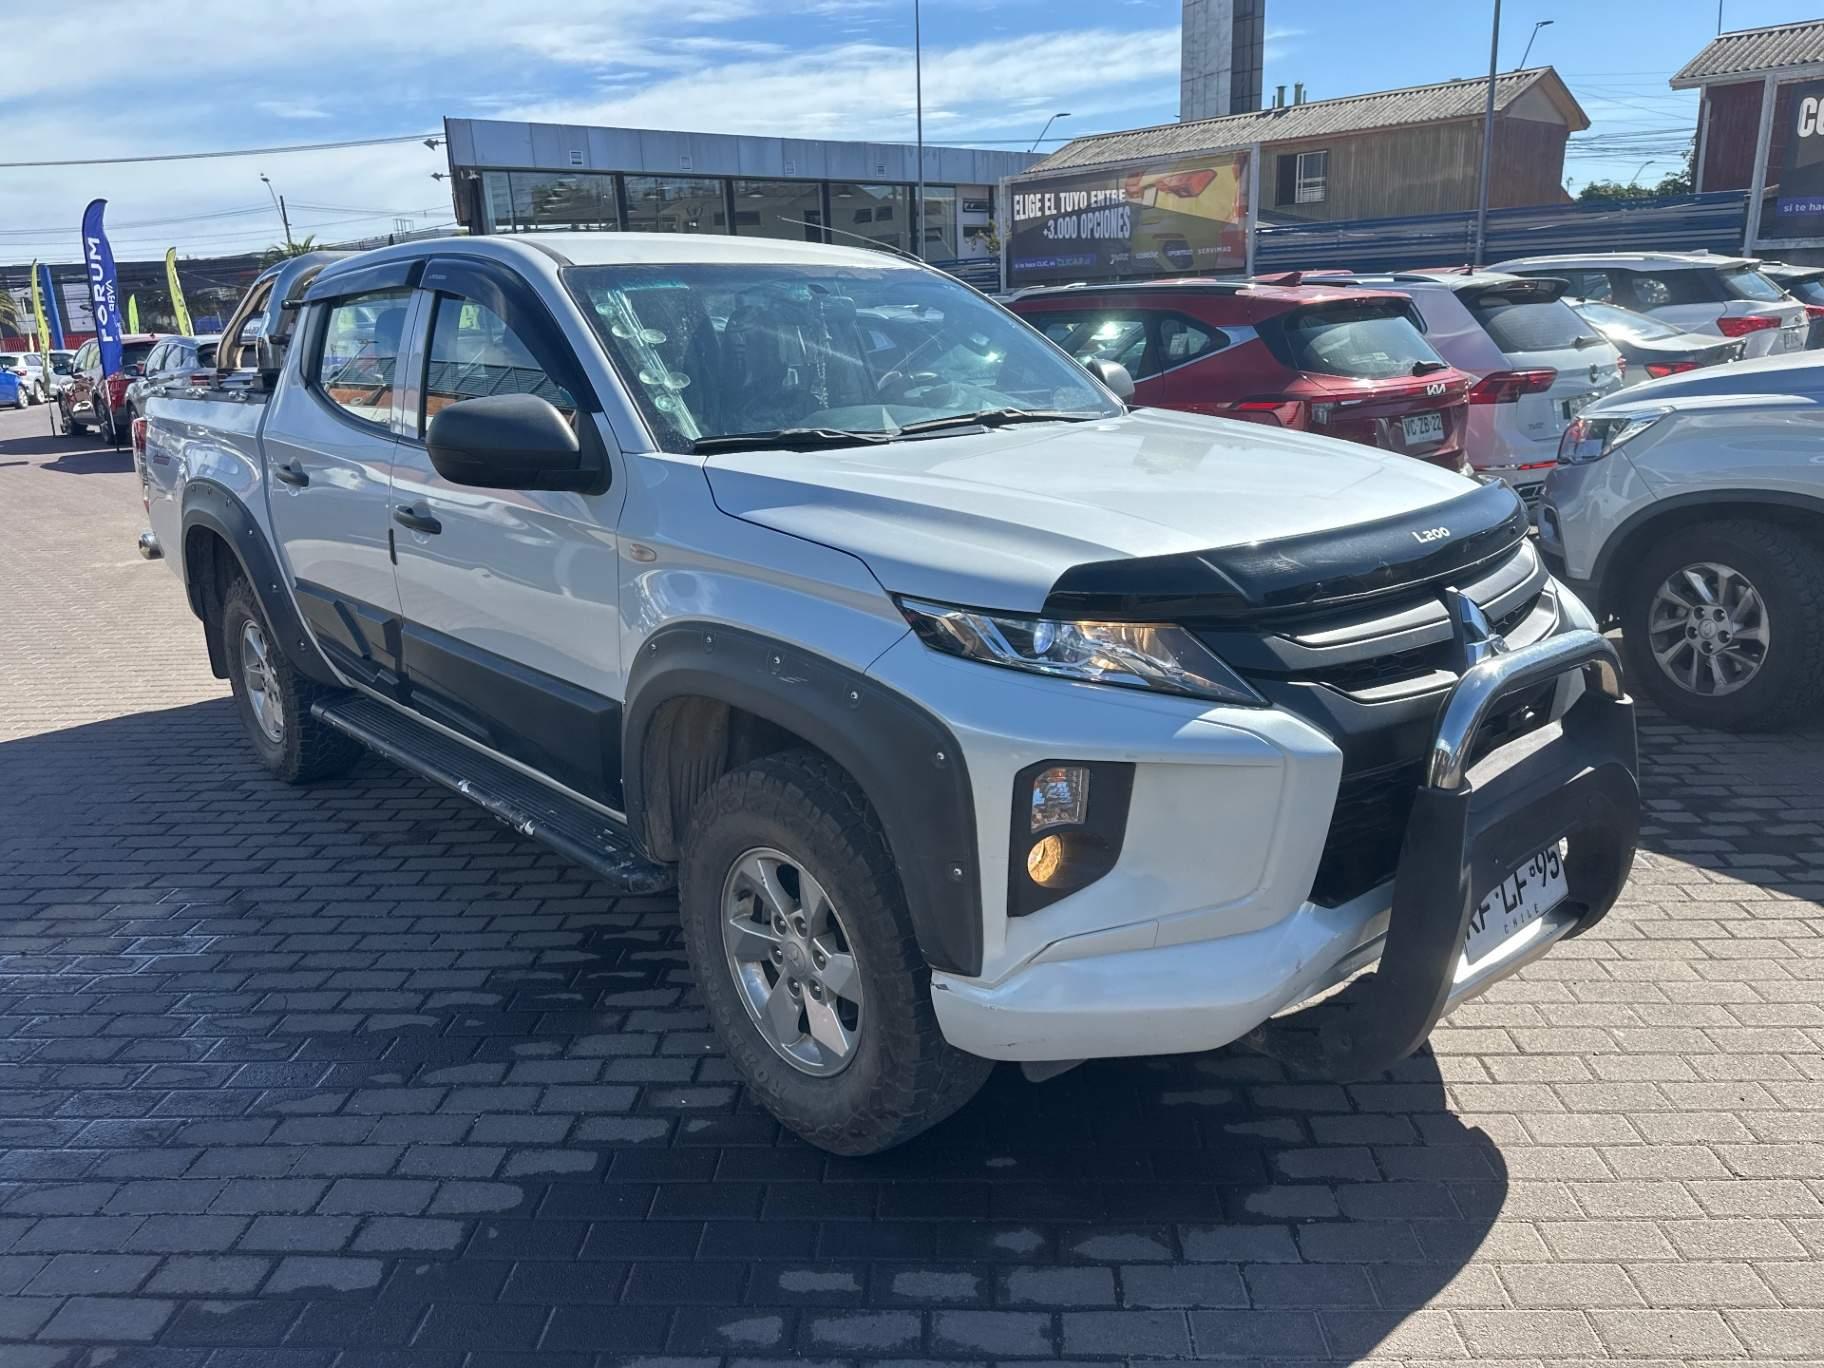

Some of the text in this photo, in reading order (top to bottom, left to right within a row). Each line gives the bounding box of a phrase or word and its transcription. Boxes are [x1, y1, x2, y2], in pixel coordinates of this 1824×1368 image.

[1013, 188, 1126, 221] ELIGE EL TUYO ENTRE
[1043, 206, 1131, 240] +3.000 OPCIONES
[87, 237, 114, 343] FORUM
[1411, 526, 1450, 543] L200
